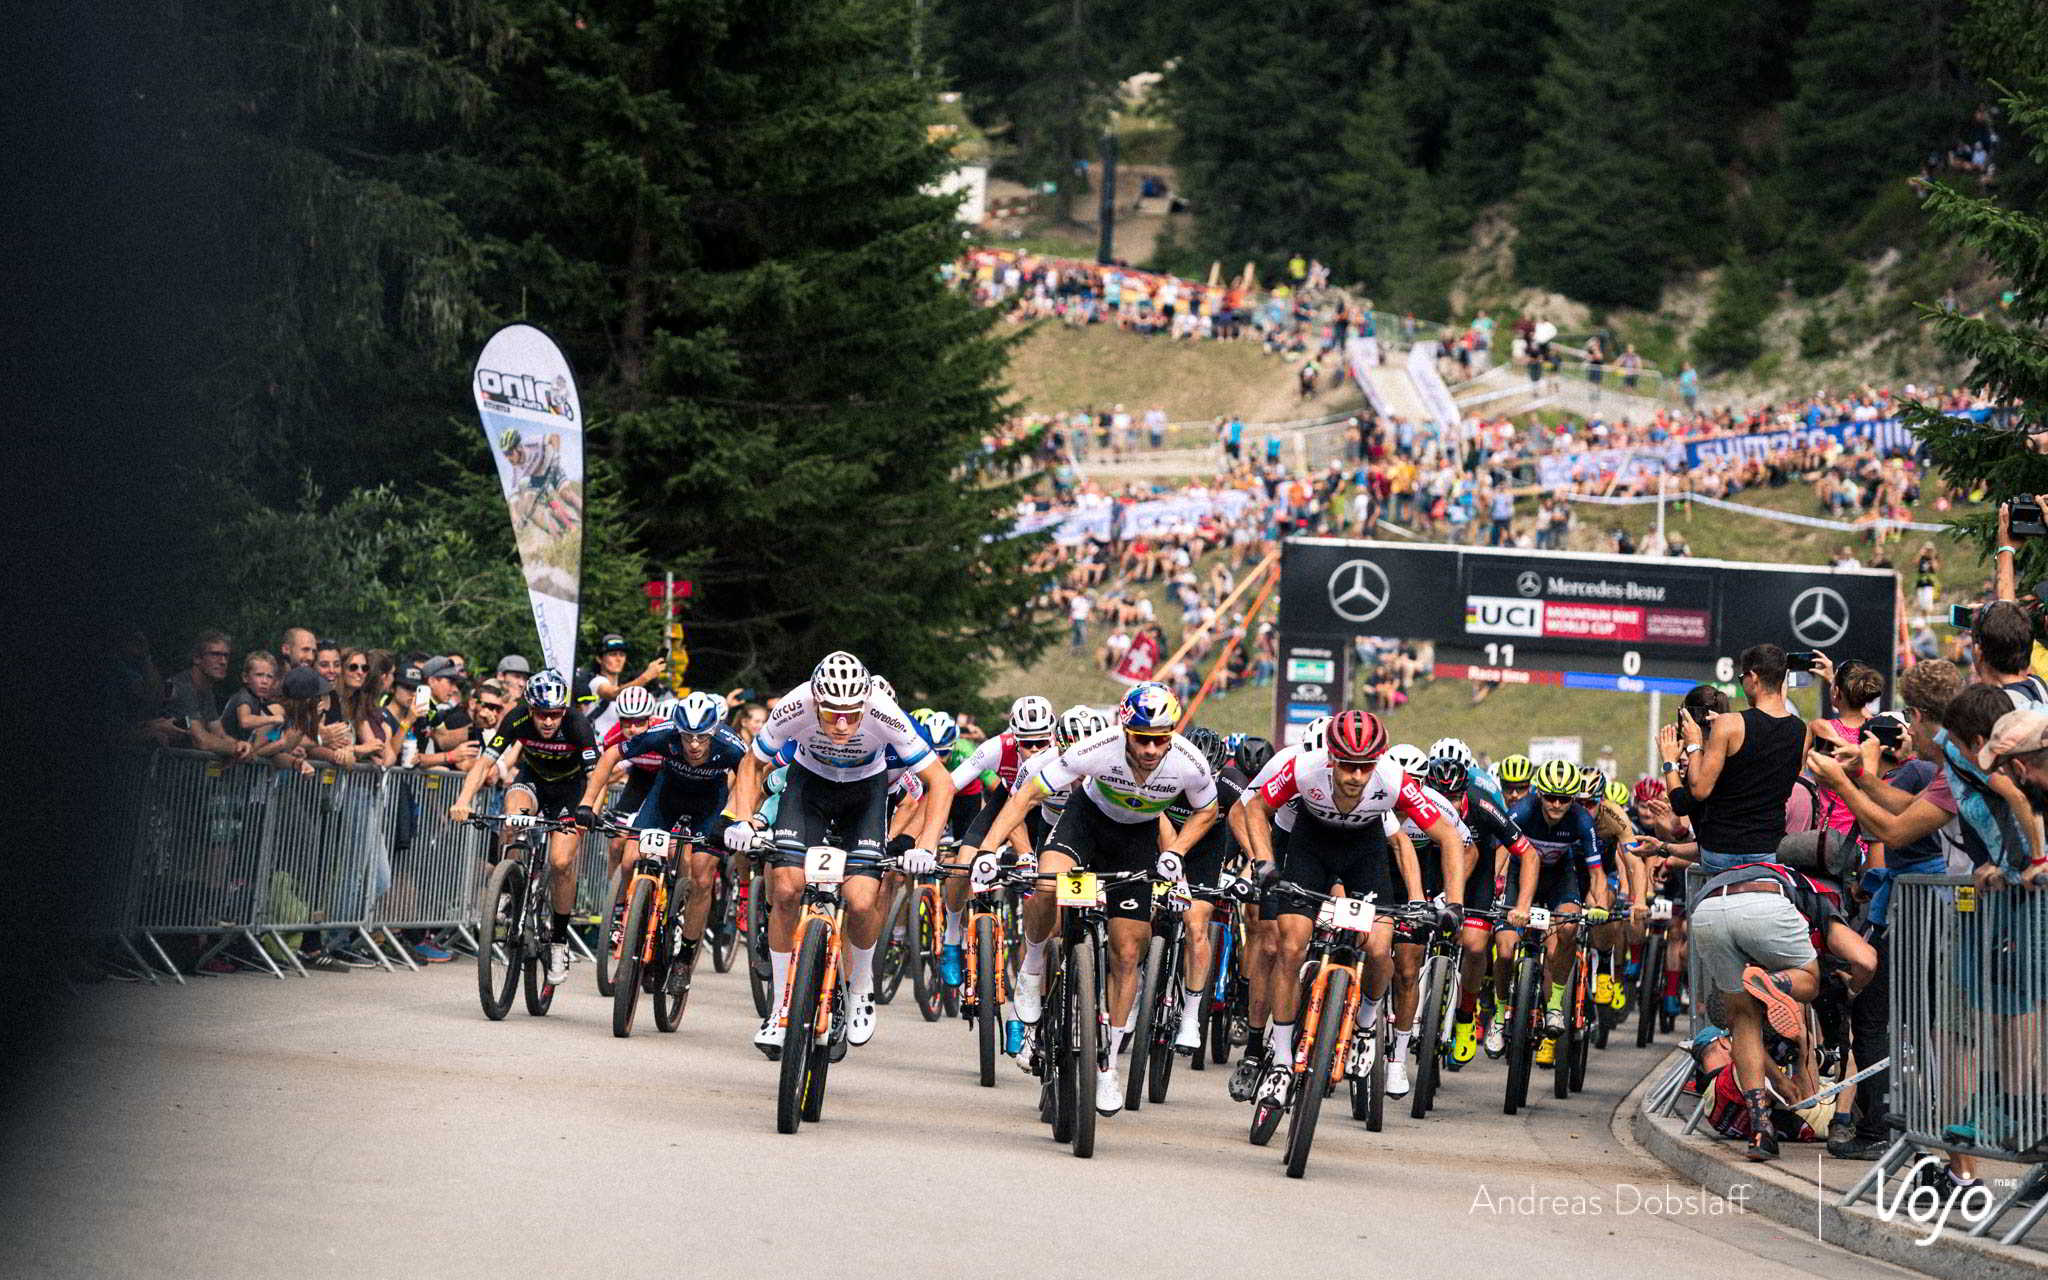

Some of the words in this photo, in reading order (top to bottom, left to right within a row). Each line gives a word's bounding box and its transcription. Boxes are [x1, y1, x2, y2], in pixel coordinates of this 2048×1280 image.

[1547, 576, 1667, 602] Mercedes-Benz
[1481, 605, 1535, 628] UCI
[1484, 642, 1515, 667] 11
[1622, 650, 1642, 675] 0
[1716, 656, 1734, 682] 6
[647, 833, 665, 848] 15
[818, 853, 832, 871] 2
[1071, 880, 1083, 895] 3
[1349, 901, 1361, 916] 9
